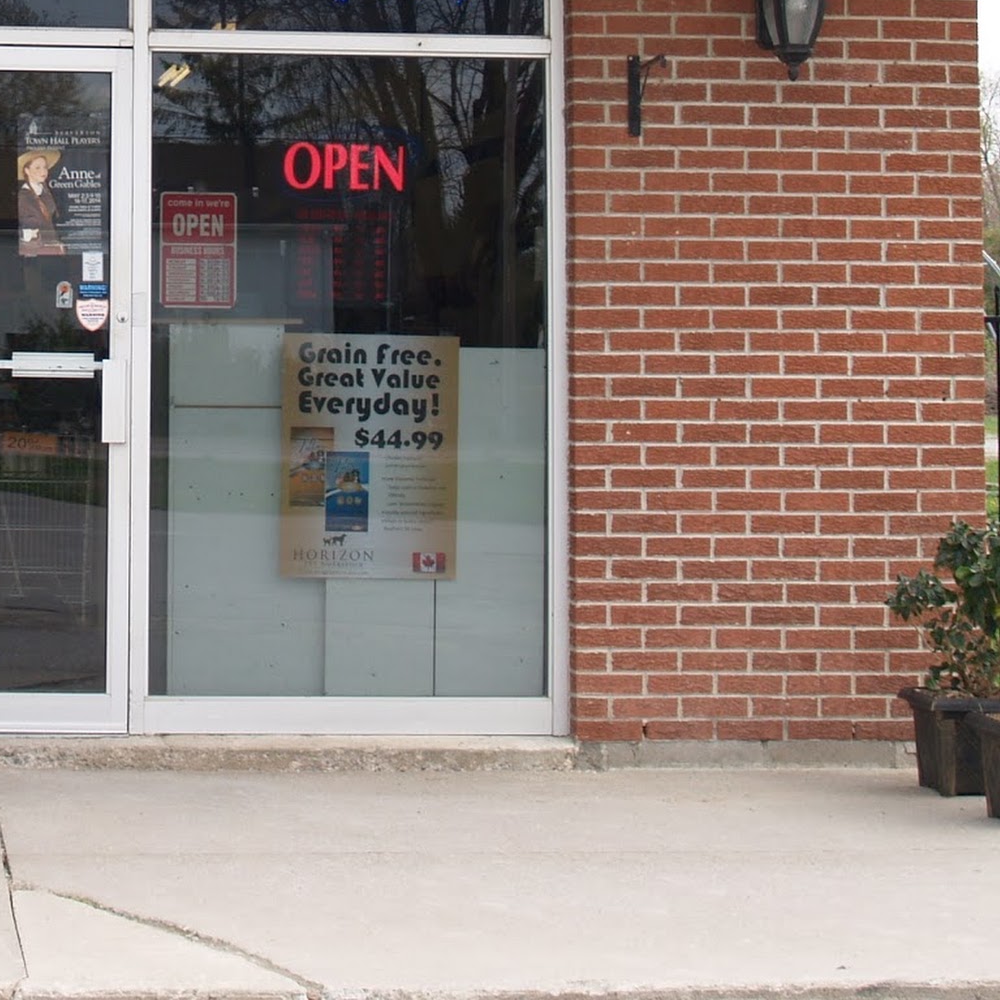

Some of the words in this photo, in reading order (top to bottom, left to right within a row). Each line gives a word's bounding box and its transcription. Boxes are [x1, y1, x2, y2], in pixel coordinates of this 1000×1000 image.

[58, 166, 95, 179] Anne
[283, 142, 405, 191] OPEN
[49, 180, 73, 189] Green
[74, 180, 101, 189] Gables
[195, 199, 204, 207] in
[206, 200, 230, 208] we're
[172, 213, 224, 237] OPEN
[299, 342, 367, 365] Grain
[377, 343, 442, 366] Free.
[298, 366, 365, 388] Great
[371, 368, 441, 390] Value
[298, 391, 440, 423] Everyday!
[354, 427, 443, 450] $44.99
[293, 548, 374, 561] HORIZON
